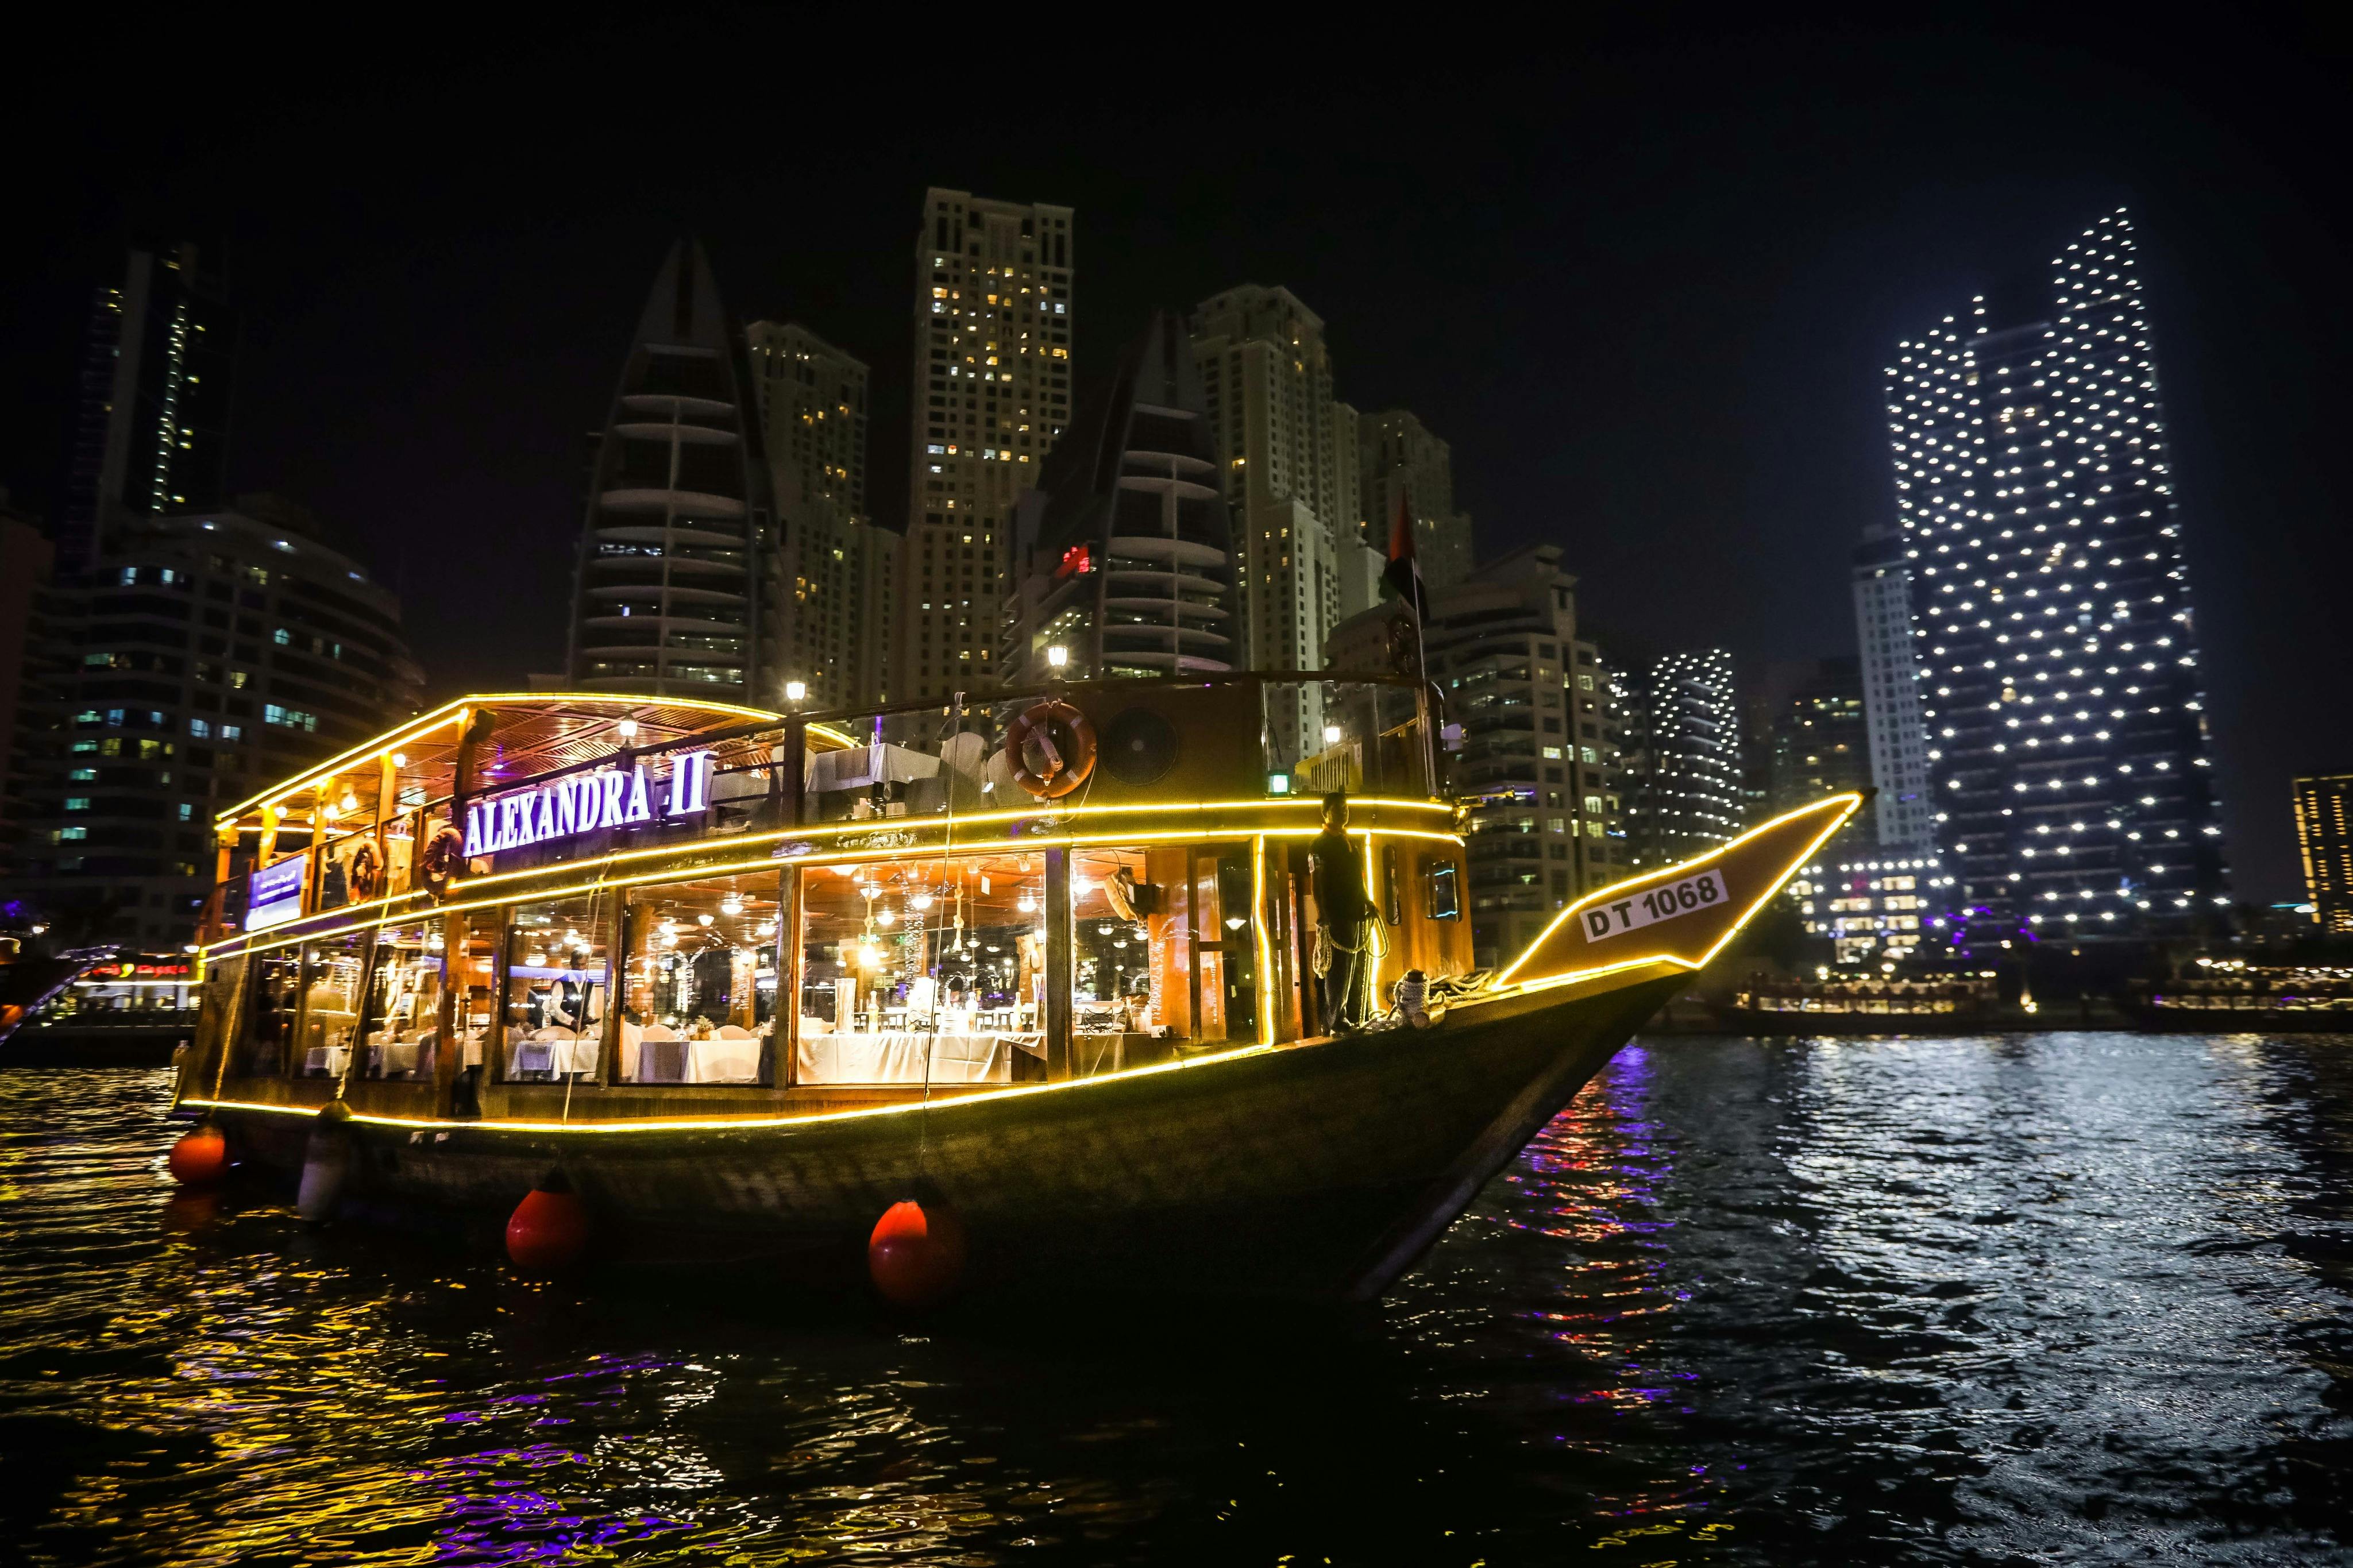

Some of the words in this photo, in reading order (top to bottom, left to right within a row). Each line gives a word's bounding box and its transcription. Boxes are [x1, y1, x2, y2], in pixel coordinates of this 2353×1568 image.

[463, 764, 651, 857] ALEXANDRA
[666, 750, 710, 816] II
[1587, 900, 1633, 937] DT
[1642, 876, 1719, 920] 1068
